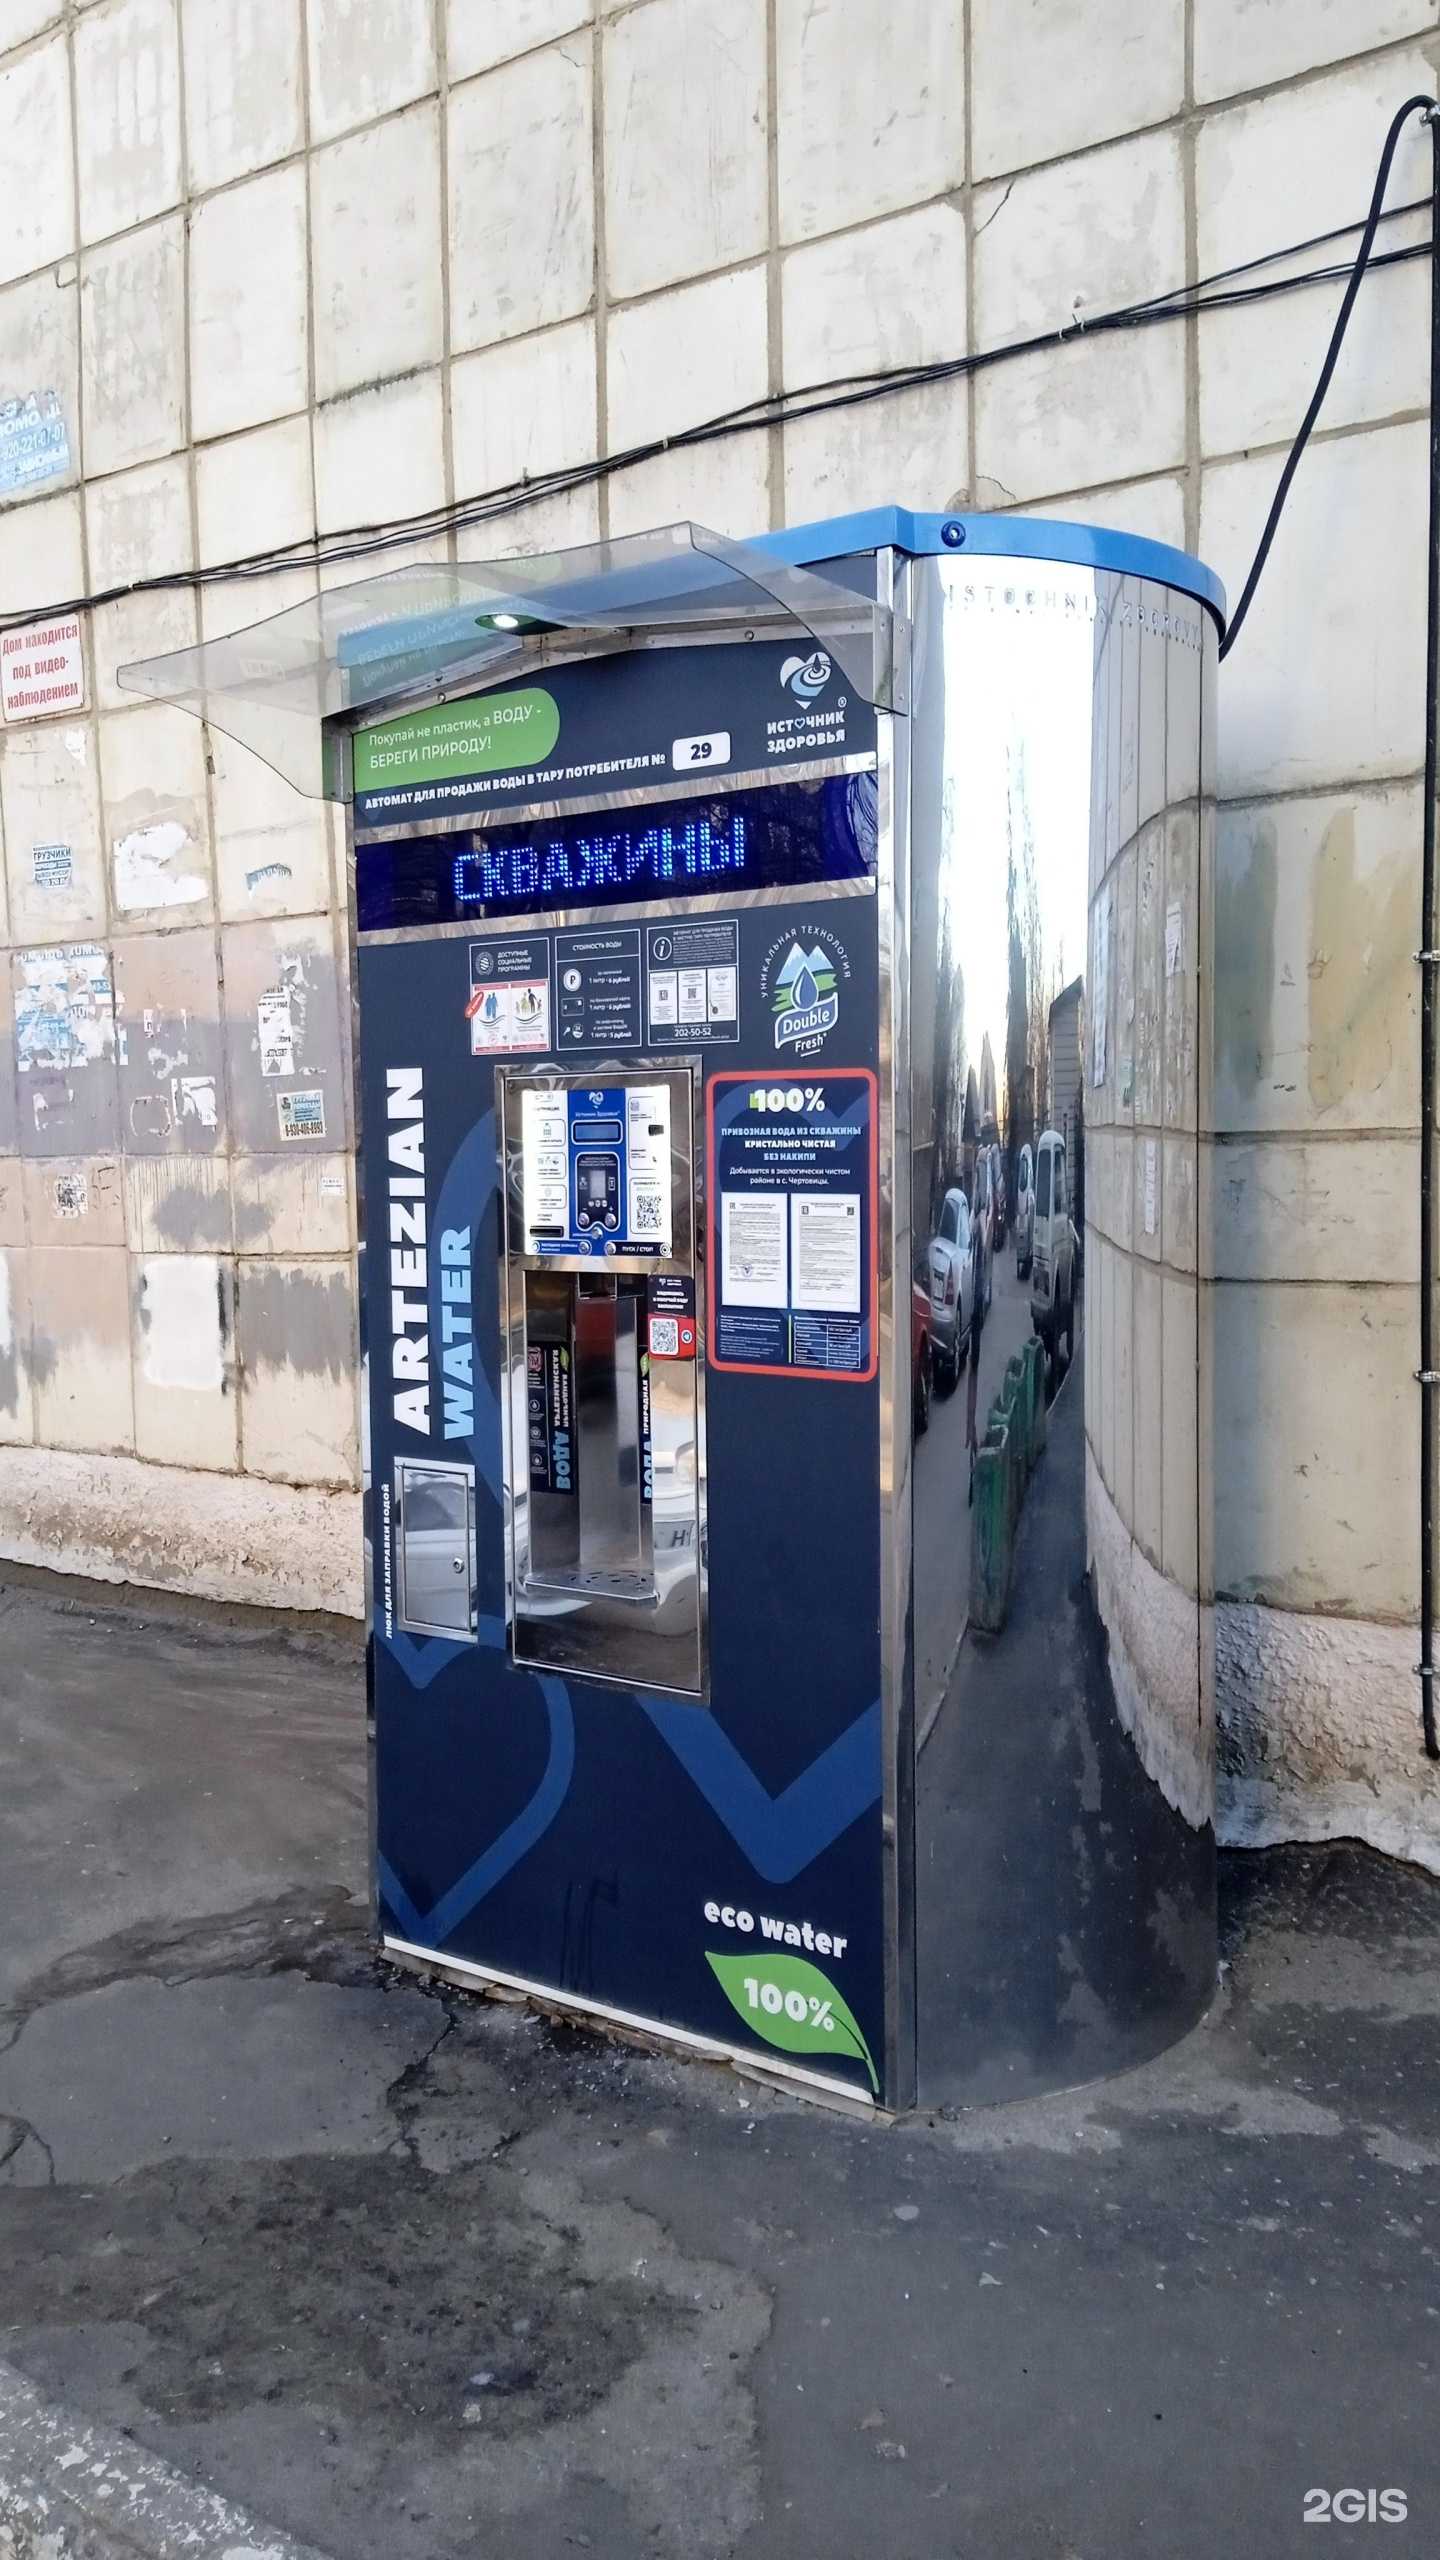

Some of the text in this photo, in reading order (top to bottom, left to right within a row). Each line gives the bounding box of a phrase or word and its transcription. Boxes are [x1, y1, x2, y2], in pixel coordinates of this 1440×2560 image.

[3, 624, 78, 656] Дом находится
[13, 656, 69, 680] под видео-
[7, 682, 79, 710] наблюдением
[369, 728, 414, 747] Покупай
[417, 727, 431, 738] не
[433, 718, 481, 735] пластик,
[484, 716, 490, 726] а
[493, 705, 533, 725] ВОДУ
[370, 735, 492, 769] БЕРЕГИ ПРИРОДУ!
[690, 742, 712, 761] 29
[767, 729, 846, 753] ЗДОРОВЬЯ
[365, 792, 414, 810] АВТОМАТ
[414, 789, 436, 803] ДЛЯ
[437, 780, 492, 798] ПРОДАЖИ
[492, 775, 526, 791] ВОДЫ
[527, 773, 535, 785] В
[536, 769, 564, 783] ТАРУ
[566, 755, 649, 779] ПОТРЕБИТЕЛЯ
[33, 847, 71, 861] ГРУЗЧИКИ
[453, 816, 745, 901] СКВАЖИНЫ
[760, 928, 798, 999] УНИКАЛЬНАЯ
[801, 925, 851, 978] ТЕХНОЛОГИЯ
[674, 1027, 711, 1037] 202-50-52
[783, 1008, 830, 1034] Double
[754, 1087, 826, 1113] 100%
[721, 1126, 861, 1136] ПРИВОЗНАЯ ВОДА ИЗ СКВАЖИНЫ
[745, 1140, 836, 1148] КРИСТАЛЬНО ЧИСТАЯ
[764, 1153, 816, 1161] БЕЗ НАКИПИ
[729, 1167, 769, 1176] Добывается
[776, 1167, 824, 1176] экологически
[750, 1177, 775, 1185] районе
[386, 1067, 431, 1436] ARTEZIAN
[440, 1225, 475, 1440] WATER
[381, 1483, 393, 1640] ЛЮК ДЛЯ ЗАПРАВКИ ВОДОЙ
[704, 1902, 755, 1933] eco
[760, 1915, 848, 1959] water
[743, 1977, 835, 2032] 100%
